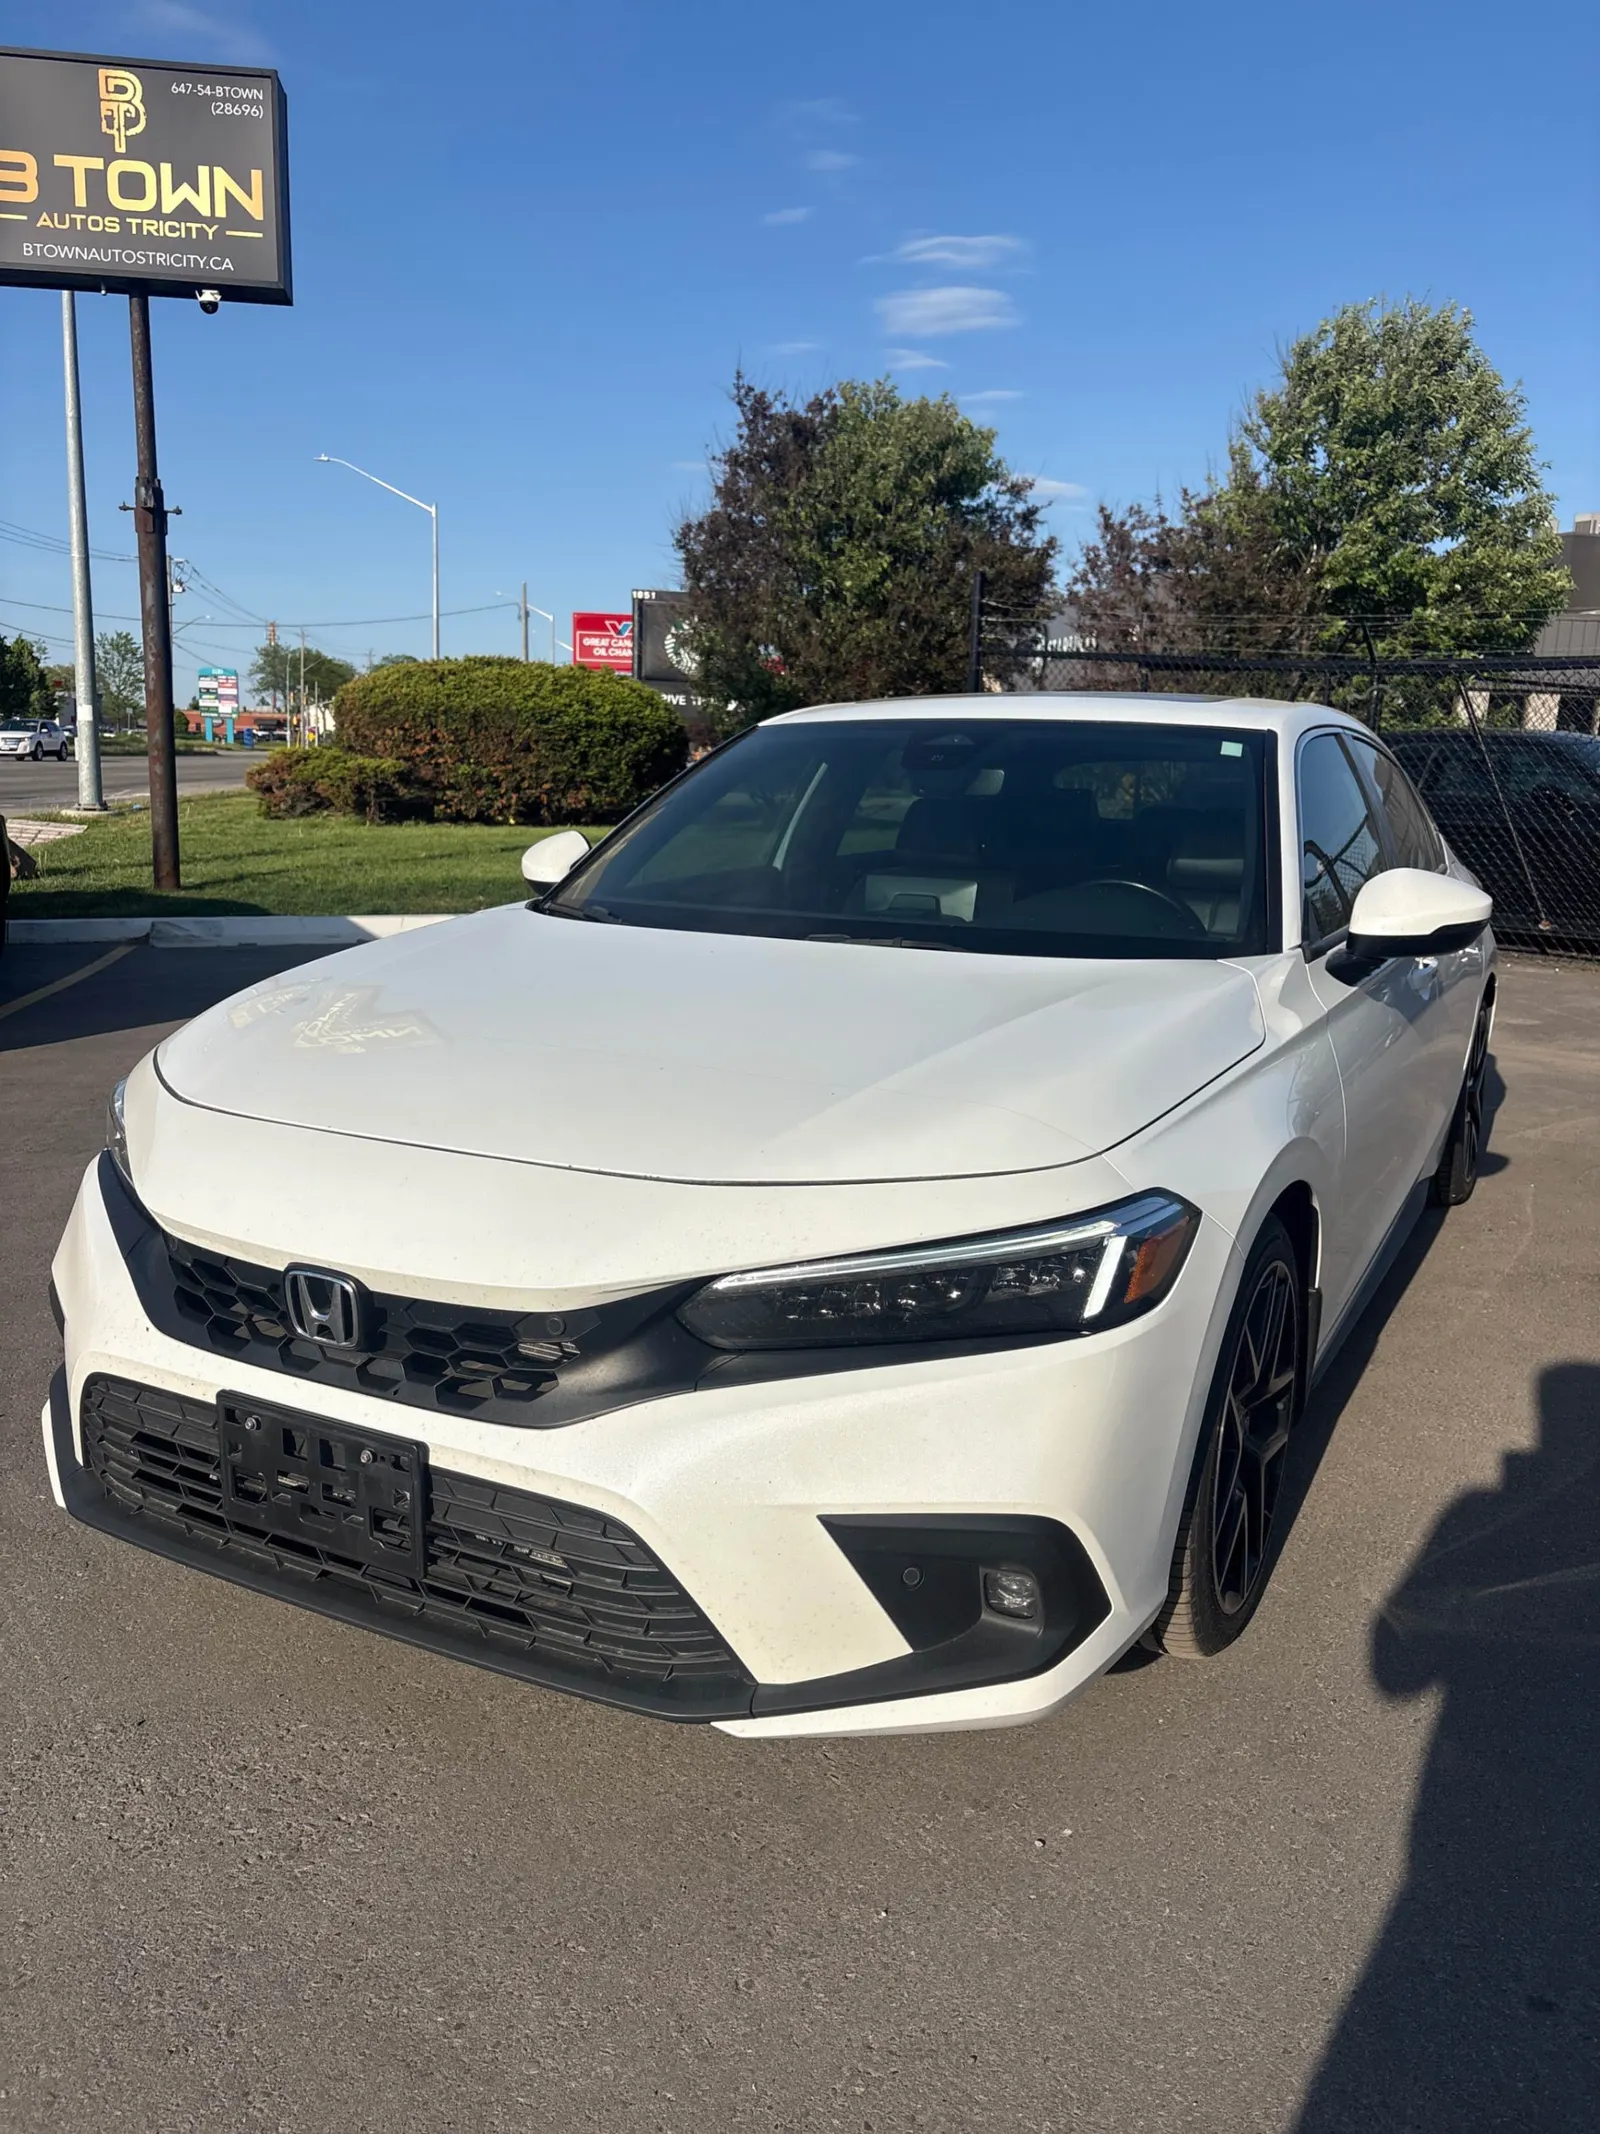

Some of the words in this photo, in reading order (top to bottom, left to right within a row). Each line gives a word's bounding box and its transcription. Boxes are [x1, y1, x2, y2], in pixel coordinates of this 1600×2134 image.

[171, 82, 263, 100] 647-54-BTOWN
[211, 102, 264, 119] (28696)
[53, 154, 264, 221] TOWN
[36, 212, 120, 233] AUTOS
[126, 217, 219, 240] TRICITY
[23, 242, 234, 271] BTOWNAUTOSTRICITY.CA
[582, 637, 610, 647] GREAT
[592, 647, 607, 656] OIL
